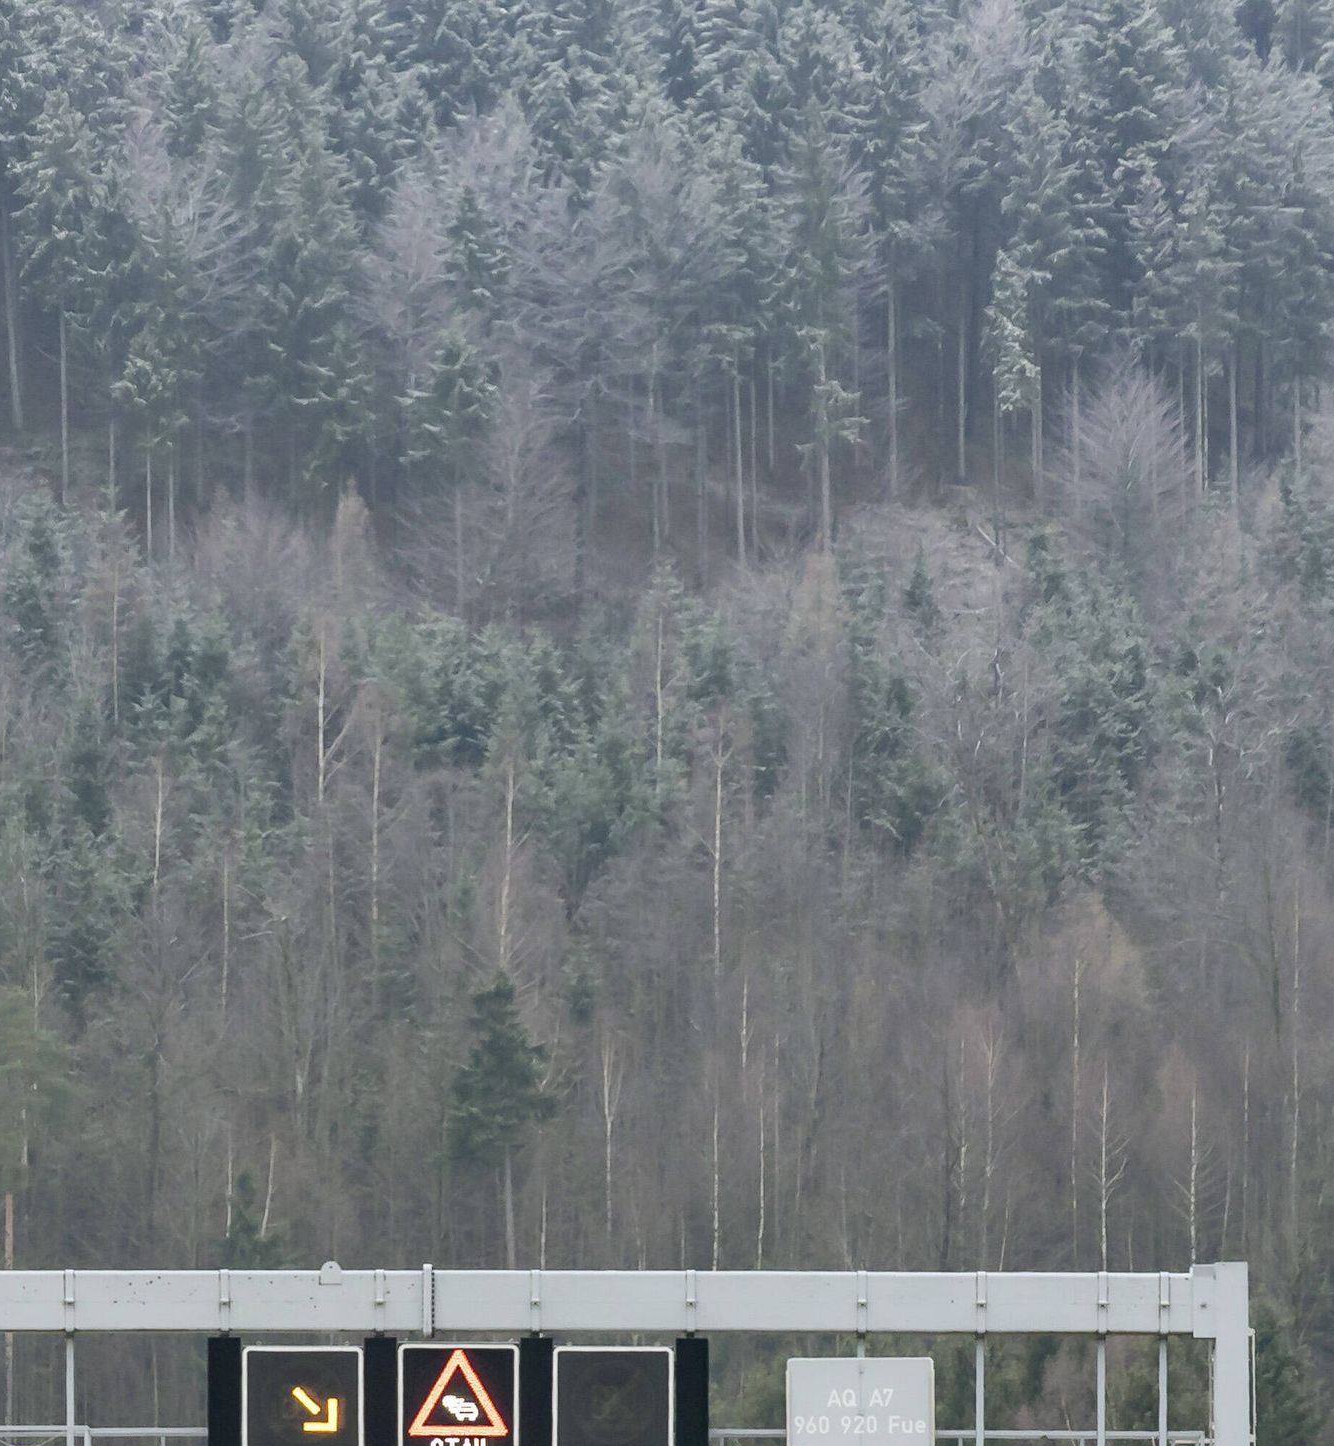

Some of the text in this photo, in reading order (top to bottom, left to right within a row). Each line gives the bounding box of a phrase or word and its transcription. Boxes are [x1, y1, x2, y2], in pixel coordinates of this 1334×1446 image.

[827, 1388, 894, 1408] AQ A7
[794, 1415, 927, 1435] 960 920 Fue
